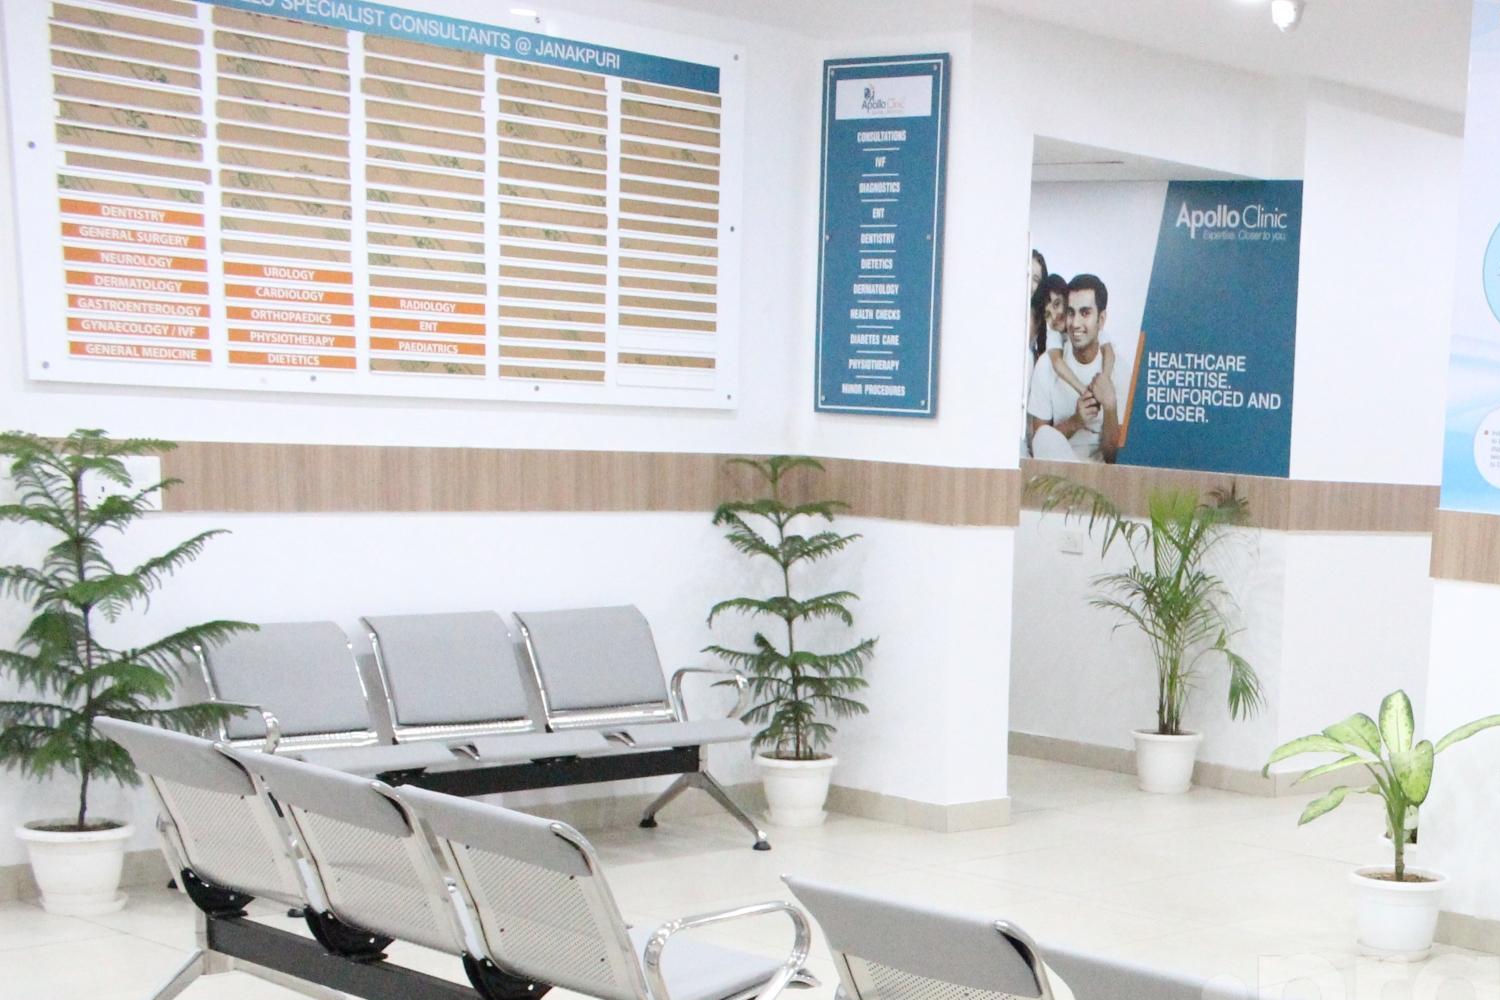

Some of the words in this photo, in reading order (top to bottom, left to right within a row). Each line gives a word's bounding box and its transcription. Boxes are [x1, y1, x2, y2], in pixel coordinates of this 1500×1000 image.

[281, 0, 384, 26] SPECIALIST
[390, 15, 510, 49] CONSULTANTS
[515, 37, 531, 55] @
[536, 40, 620, 69] JANAKPURI
[875, 156, 886, 167] IVF
[859, 182, 900, 193] DIAGNOSTICS
[102, 205, 165, 222] DENTISTRY
[873, 208, 884, 219] ENT
[1176, 202, 1240, 239] Apollo
[1243, 204, 1287, 229] Clinic
[79, 226, 135, 241] GENERAL
[137, 232, 189, 247] SURGERY
[861, 233, 895, 244] DENTISTRY
[101, 252, 172, 268] NEUROLOGY
[861, 259, 893, 269] DIETETICS
[264, 267, 316, 280] UROLOGY
[95, 275, 182, 292] DERMATOLOGY
[854, 284, 899, 295] DERMATOLOGY
[256, 287, 324, 302] CARDIOLOGY
[77, 298, 201, 316] GASTROENTEROLOGY
[400, 300, 456, 313] RADIOLOGY
[251, 309, 332, 324] ORTHOPAEDICS
[850, 309, 873, 320] HEALTH
[876, 309, 900, 320] CHECKS
[81, 319, 168, 336] GYNAECOLOGY
[178, 327, 196, 337] IVF
[420, 322, 438, 332] ENT
[250, 332, 335, 347] PHYSIOTHERAPY
[850, 334, 880, 345] DIABETES
[882, 335, 899, 345] CARE
[86, 344, 140, 357] GENERAL
[143, 347, 197, 360] MEDICINE
[399, 342, 458, 354] PAEDIATRICS
[268, 354, 320, 366] DIETETICS
[849, 359, 899, 370] PHYSIOTHERAPY
[1149, 352, 1247, 372] HEALTHCARE
[1148, 370, 1232, 389] EXPERTISE.
[1147, 387, 1244, 407] REINFORCED
[1248, 392, 1281, 410] AND
[1146, 405, 1209, 423] CLOSER.
